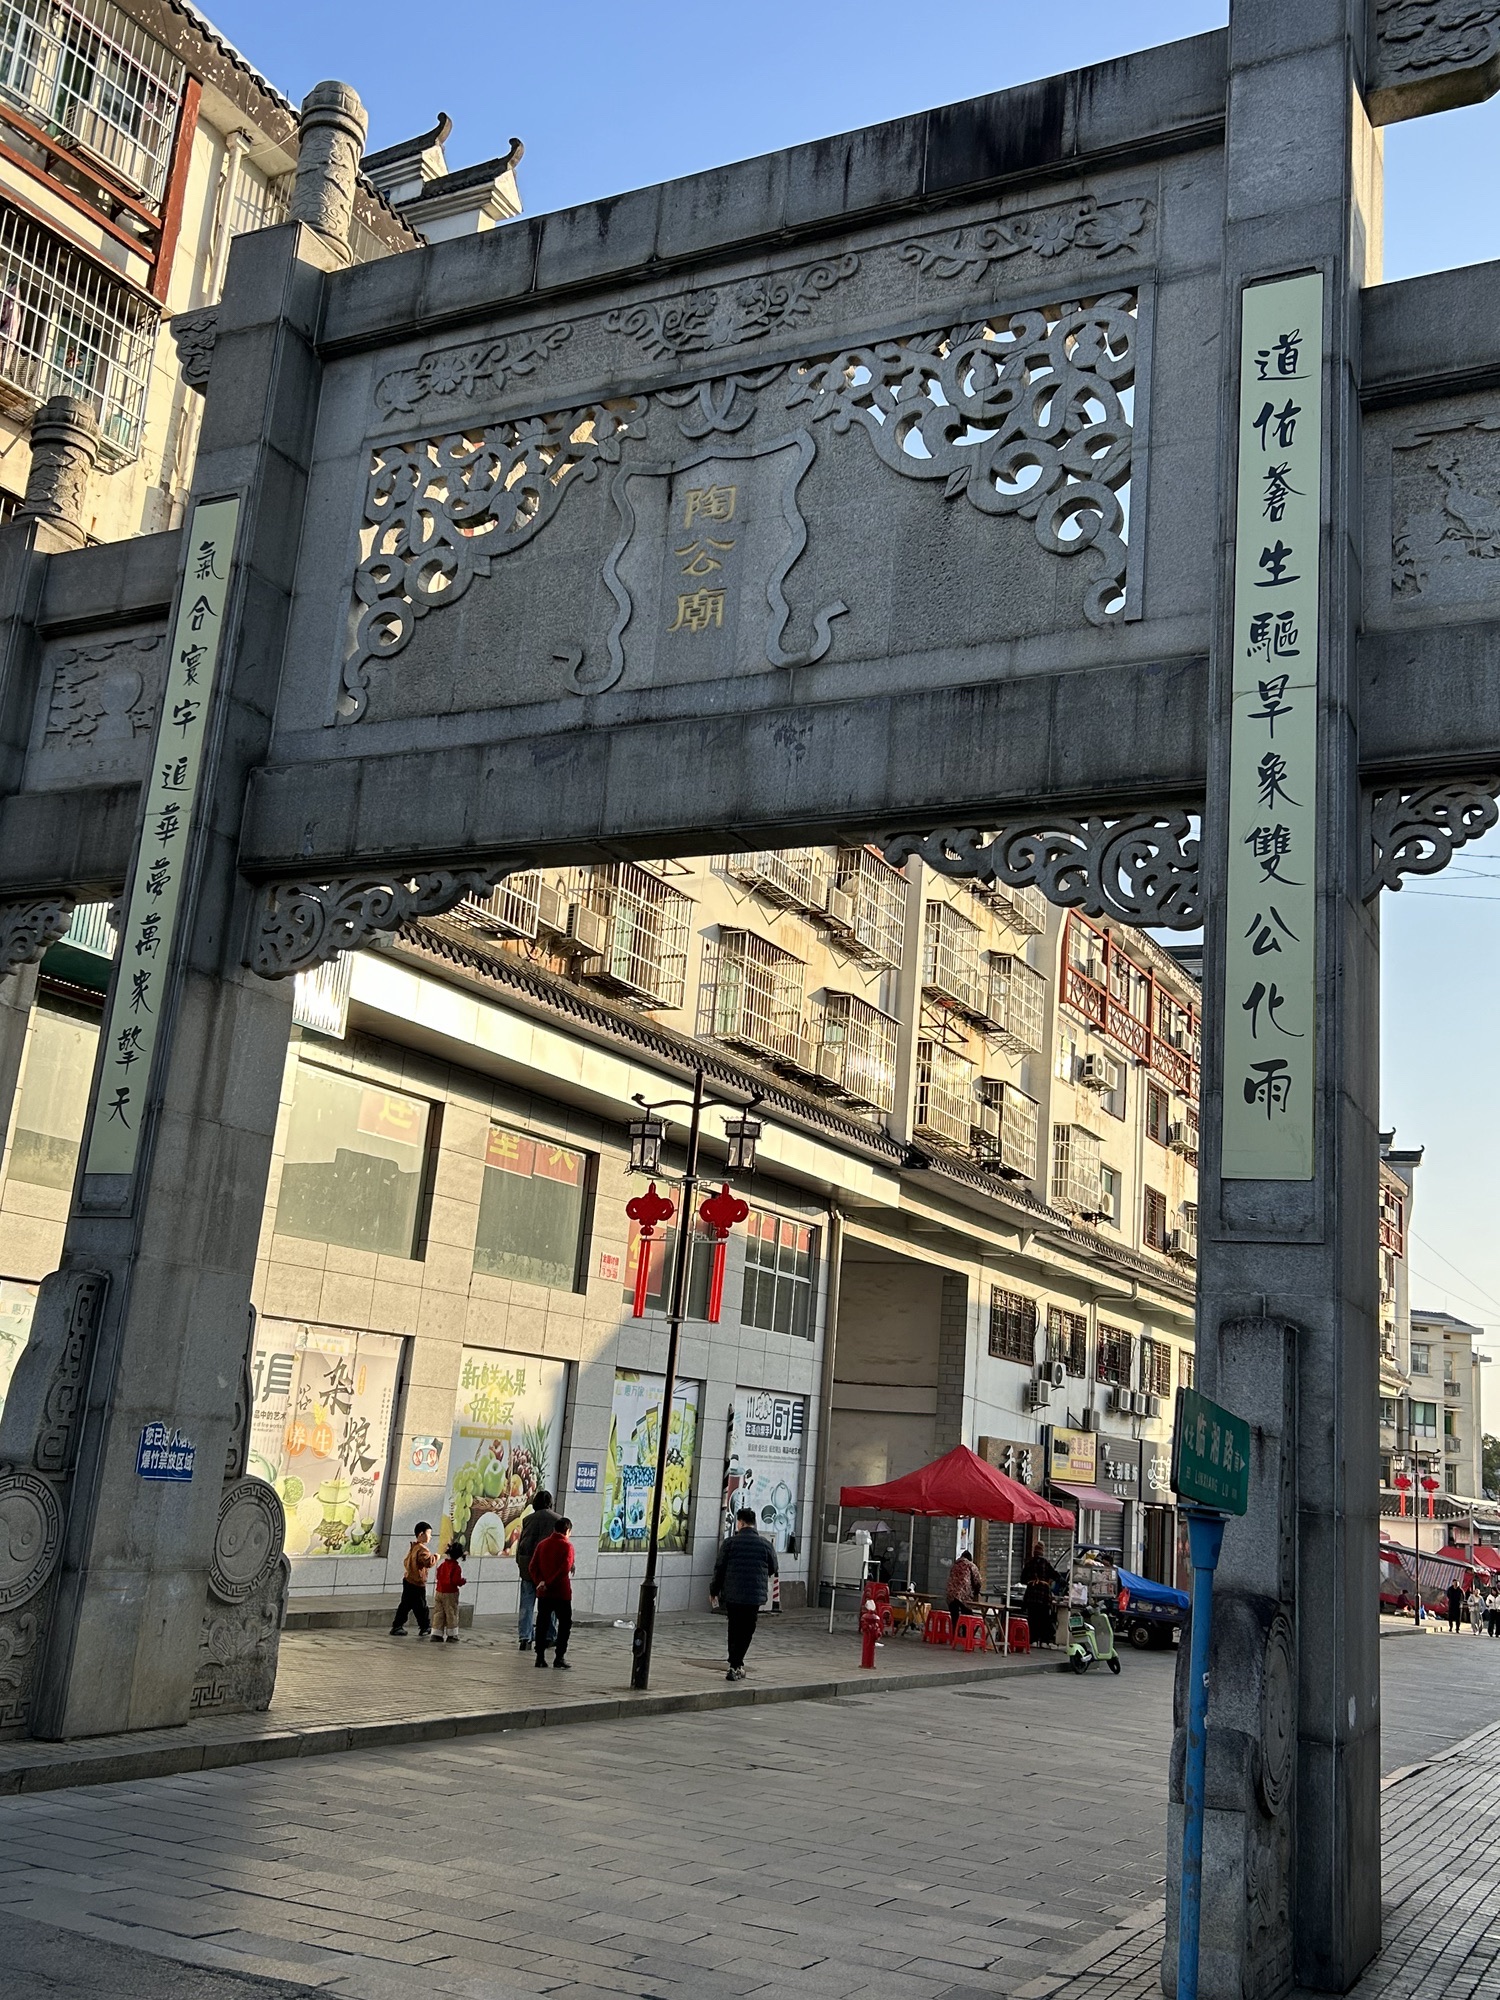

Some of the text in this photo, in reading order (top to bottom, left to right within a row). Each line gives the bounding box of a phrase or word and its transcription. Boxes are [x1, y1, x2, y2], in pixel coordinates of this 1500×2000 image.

[666, 483, 737, 633] 陶公廟
[461, 1357, 527, 1397] 新鲜水果
[469, 1393, 516, 1428] 快来买
[769, 1398, 804, 1441] 厨具
[288, 1425, 331, 1453] 养生
[140, 1449, 194, 1471] 爆竹禁放区域
